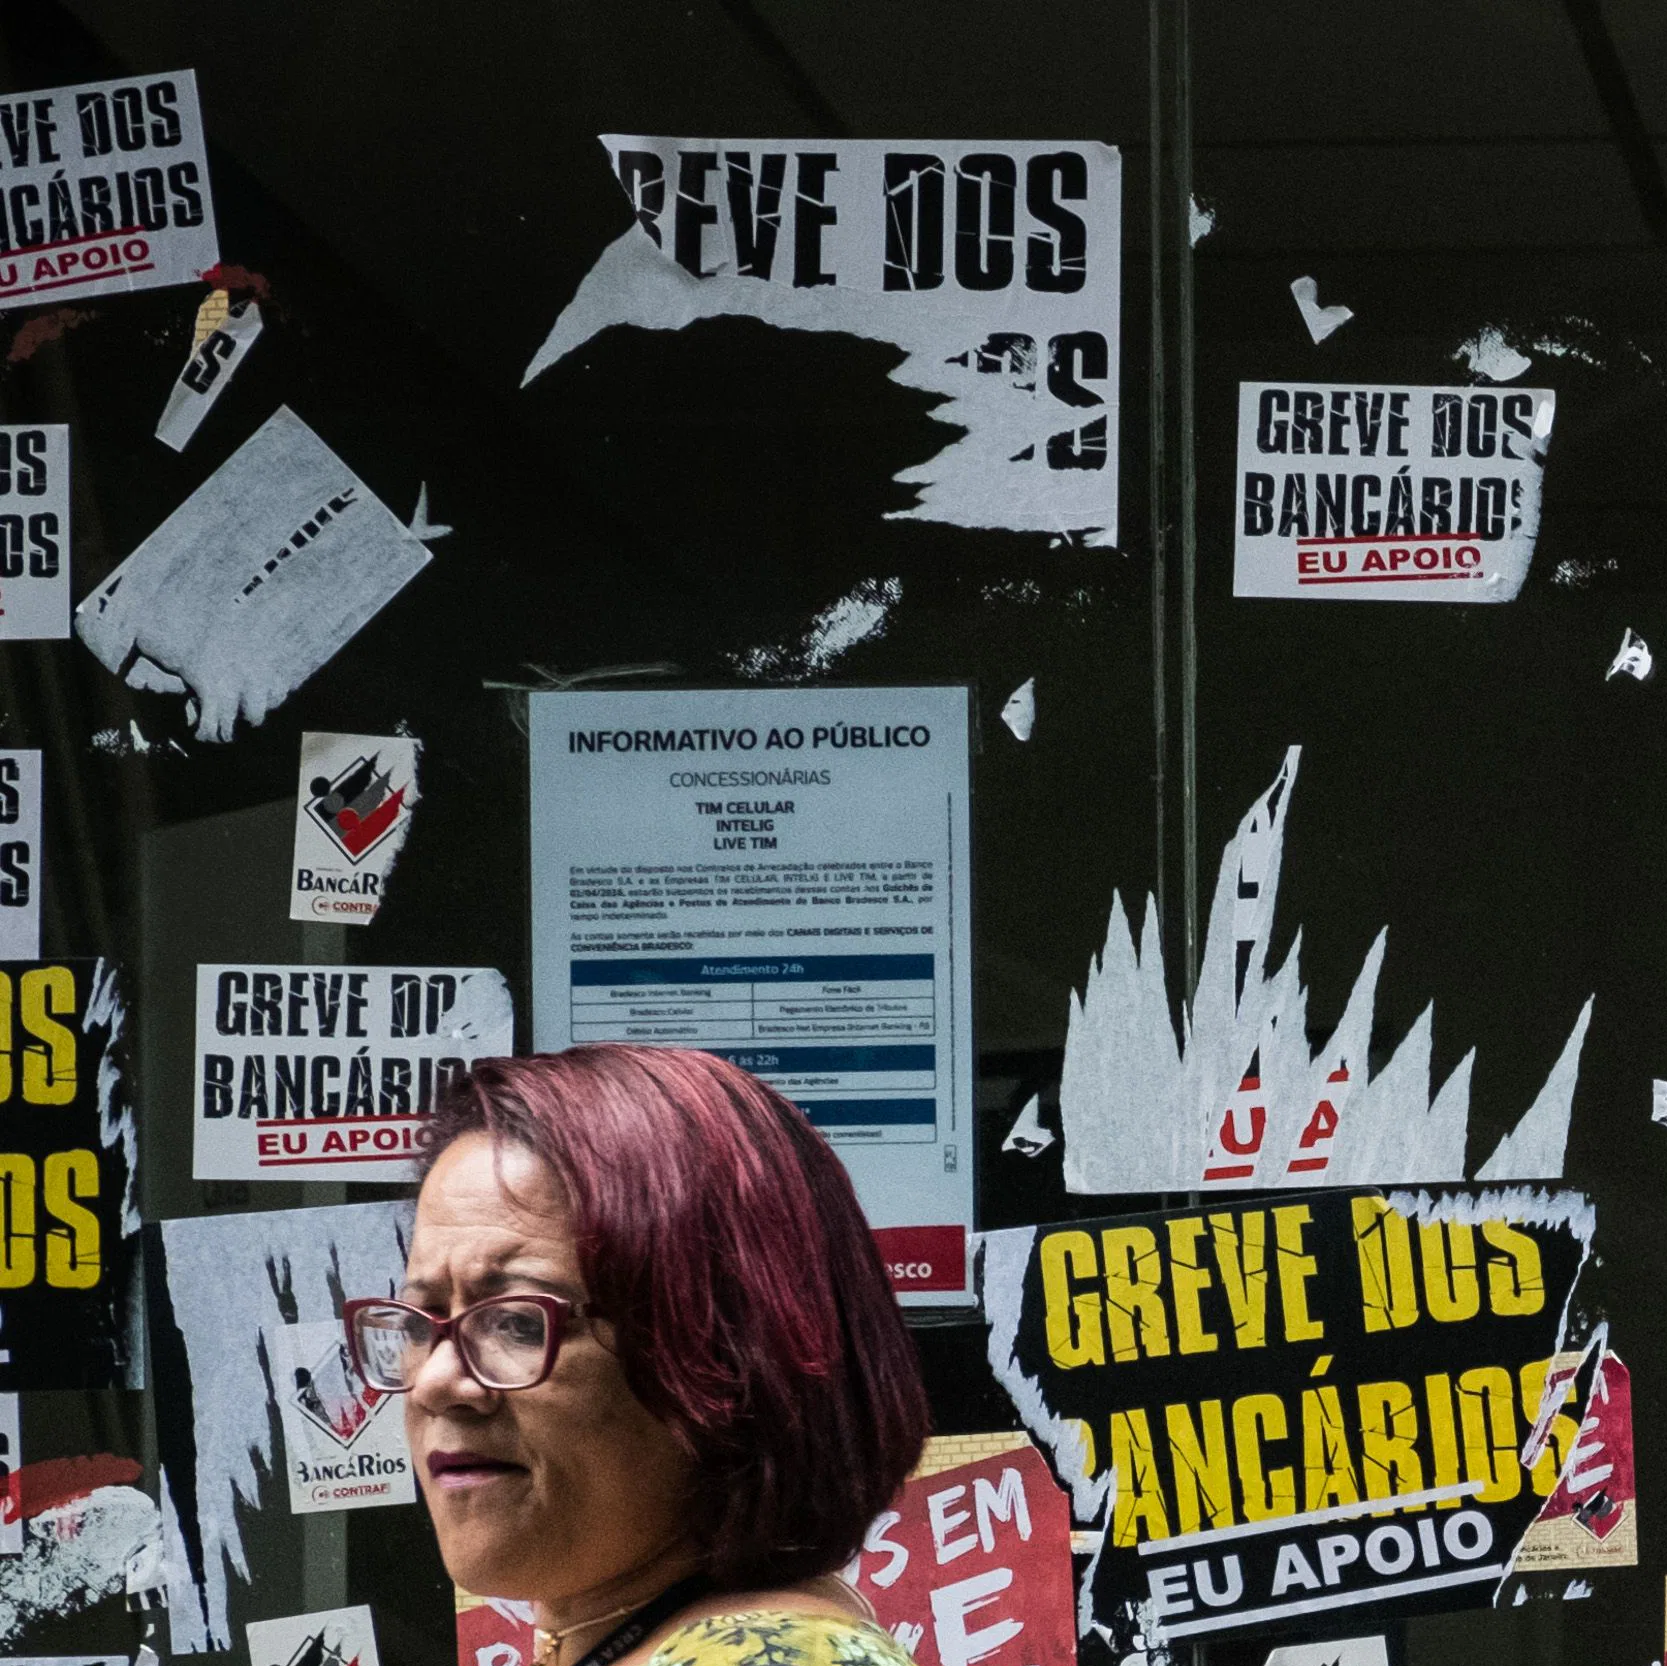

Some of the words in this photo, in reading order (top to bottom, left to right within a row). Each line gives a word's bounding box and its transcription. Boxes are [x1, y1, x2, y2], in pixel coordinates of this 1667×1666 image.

[0, 98, 60, 169] VE
[76, 81, 182, 158] DOS
[883, 151, 1088, 294] DOS
[34, 239, 149, 281] APOIO
[1257, 389, 1410, 456] GREVE
[1431, 392, 1534, 460] DOS
[1298, 550, 1348, 574] EU
[1362, 546, 1482, 572] APOIO
[568, 729, 757, 753] INFORMATIVO
[765, 728, 805, 750] AO
[812, 722, 931, 748] PÚBLICO
[669, 769, 831, 788] CONCESSIONÁRIAS
[695, 801, 722, 815] TIM
[726, 801, 795, 815] CELULAR
[716, 819, 775, 833] INTELIG
[713, 837, 747, 850] LIVE
[751, 837, 778, 850] TIM
[701, 963, 779, 977] Atendimento
[782, 962, 804, 975] 24h
[216, 971, 368, 1037] GREVE
[391, 974, 477, 1038] DO
[258, 1131, 308, 1155] EU
[1040, 1203, 1324, 1370] GREVE
[1351, 1195, 1545, 1334] DOS
[927, 1467, 1033, 1565] EM
[1147, 1553, 1244, 1618] EU
[1271, 1510, 1494, 1595] APOIO
